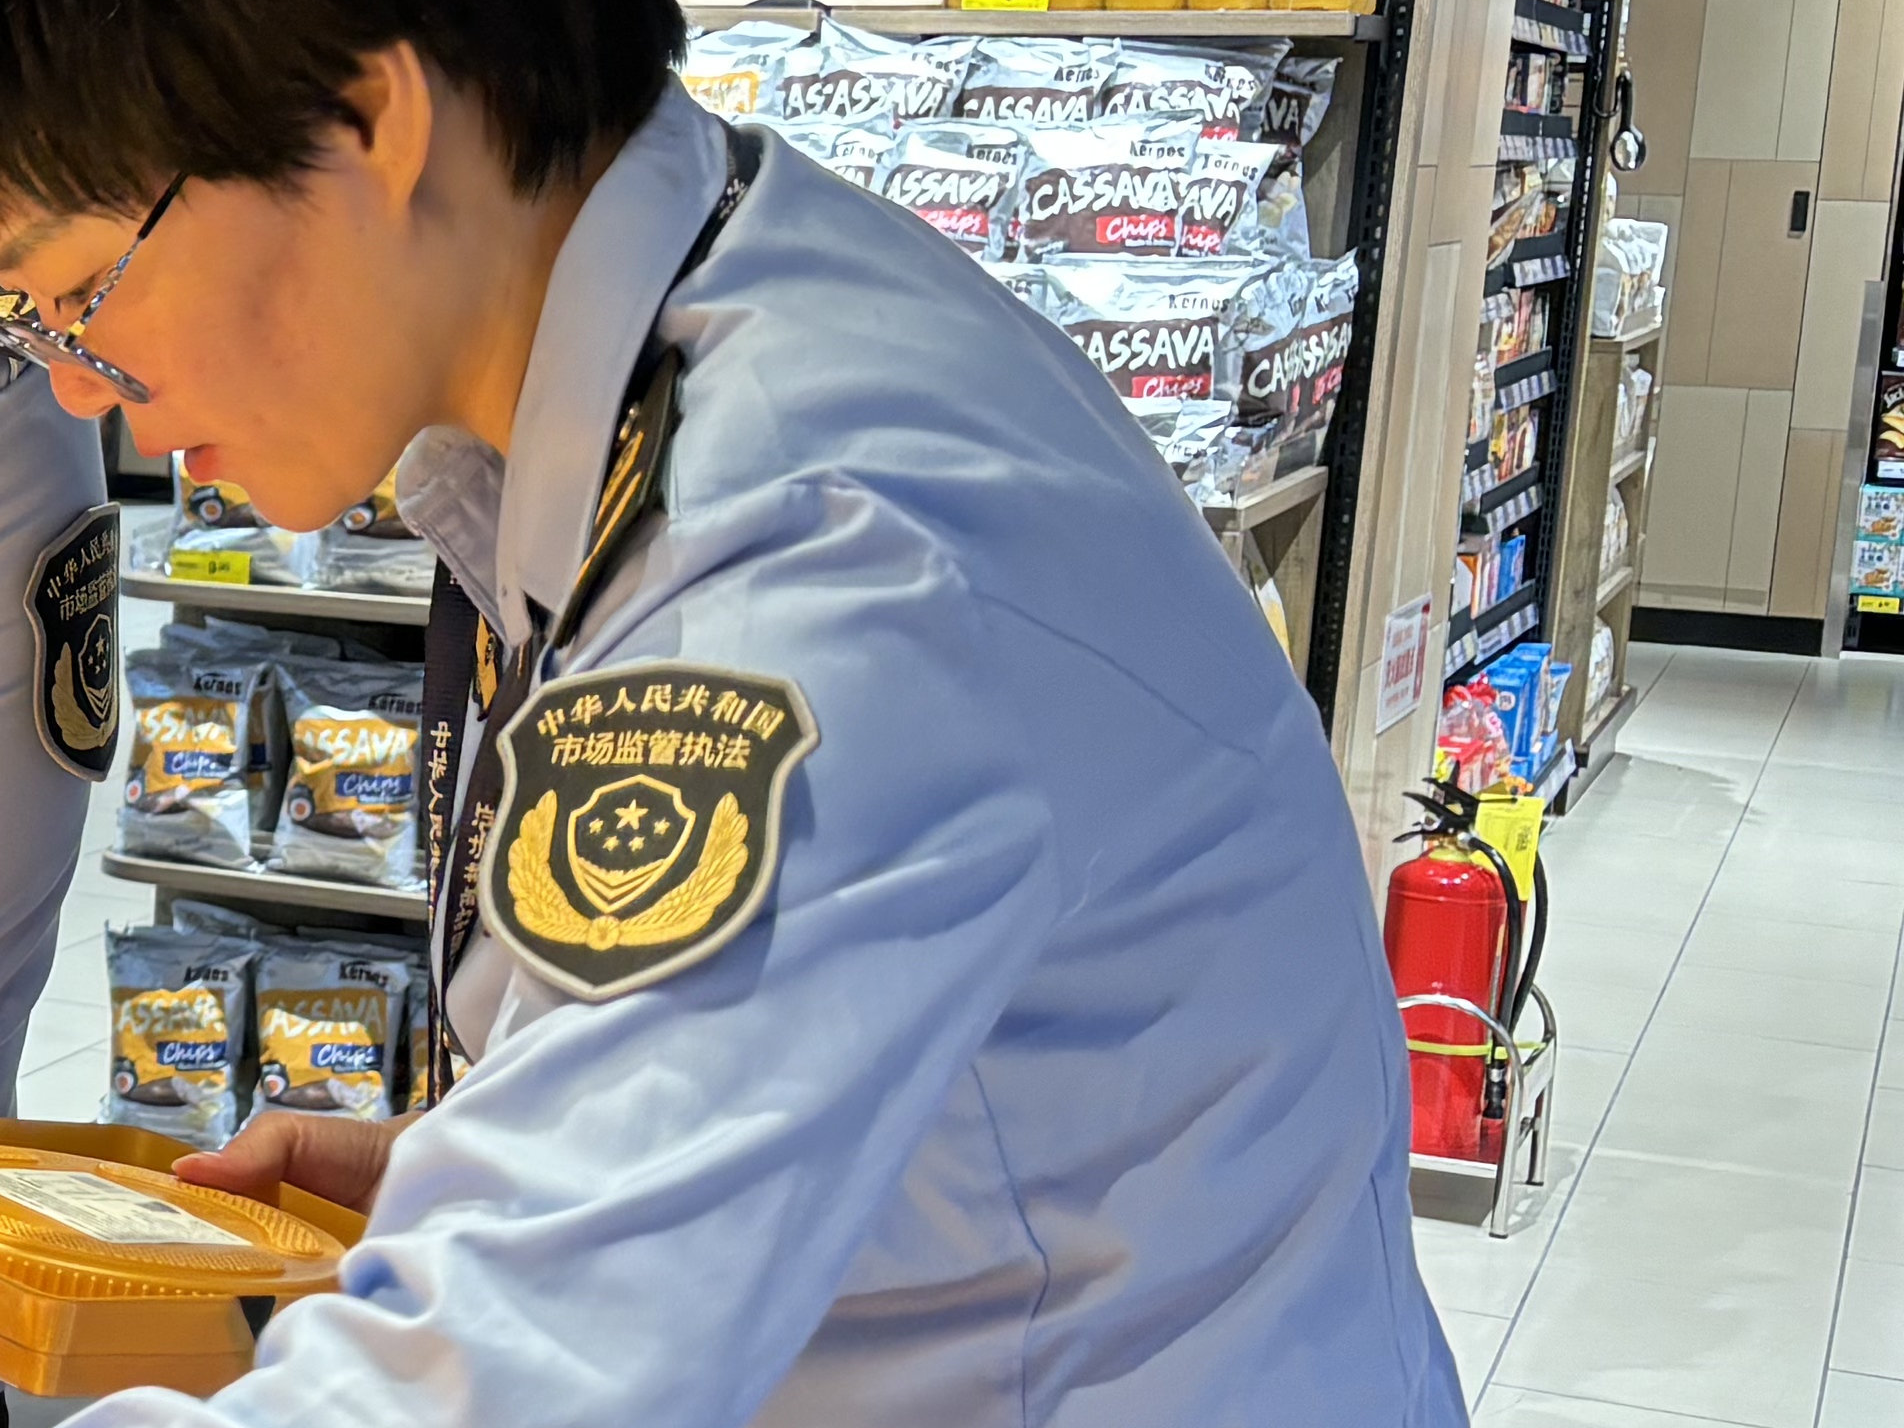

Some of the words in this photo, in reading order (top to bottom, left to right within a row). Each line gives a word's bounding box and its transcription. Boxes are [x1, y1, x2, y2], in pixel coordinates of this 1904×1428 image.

[1106, 216, 1167, 242] Chips
[537, 684, 786, 740] 中华人民共和国
[551, 729, 752, 769] 市场监管执法
